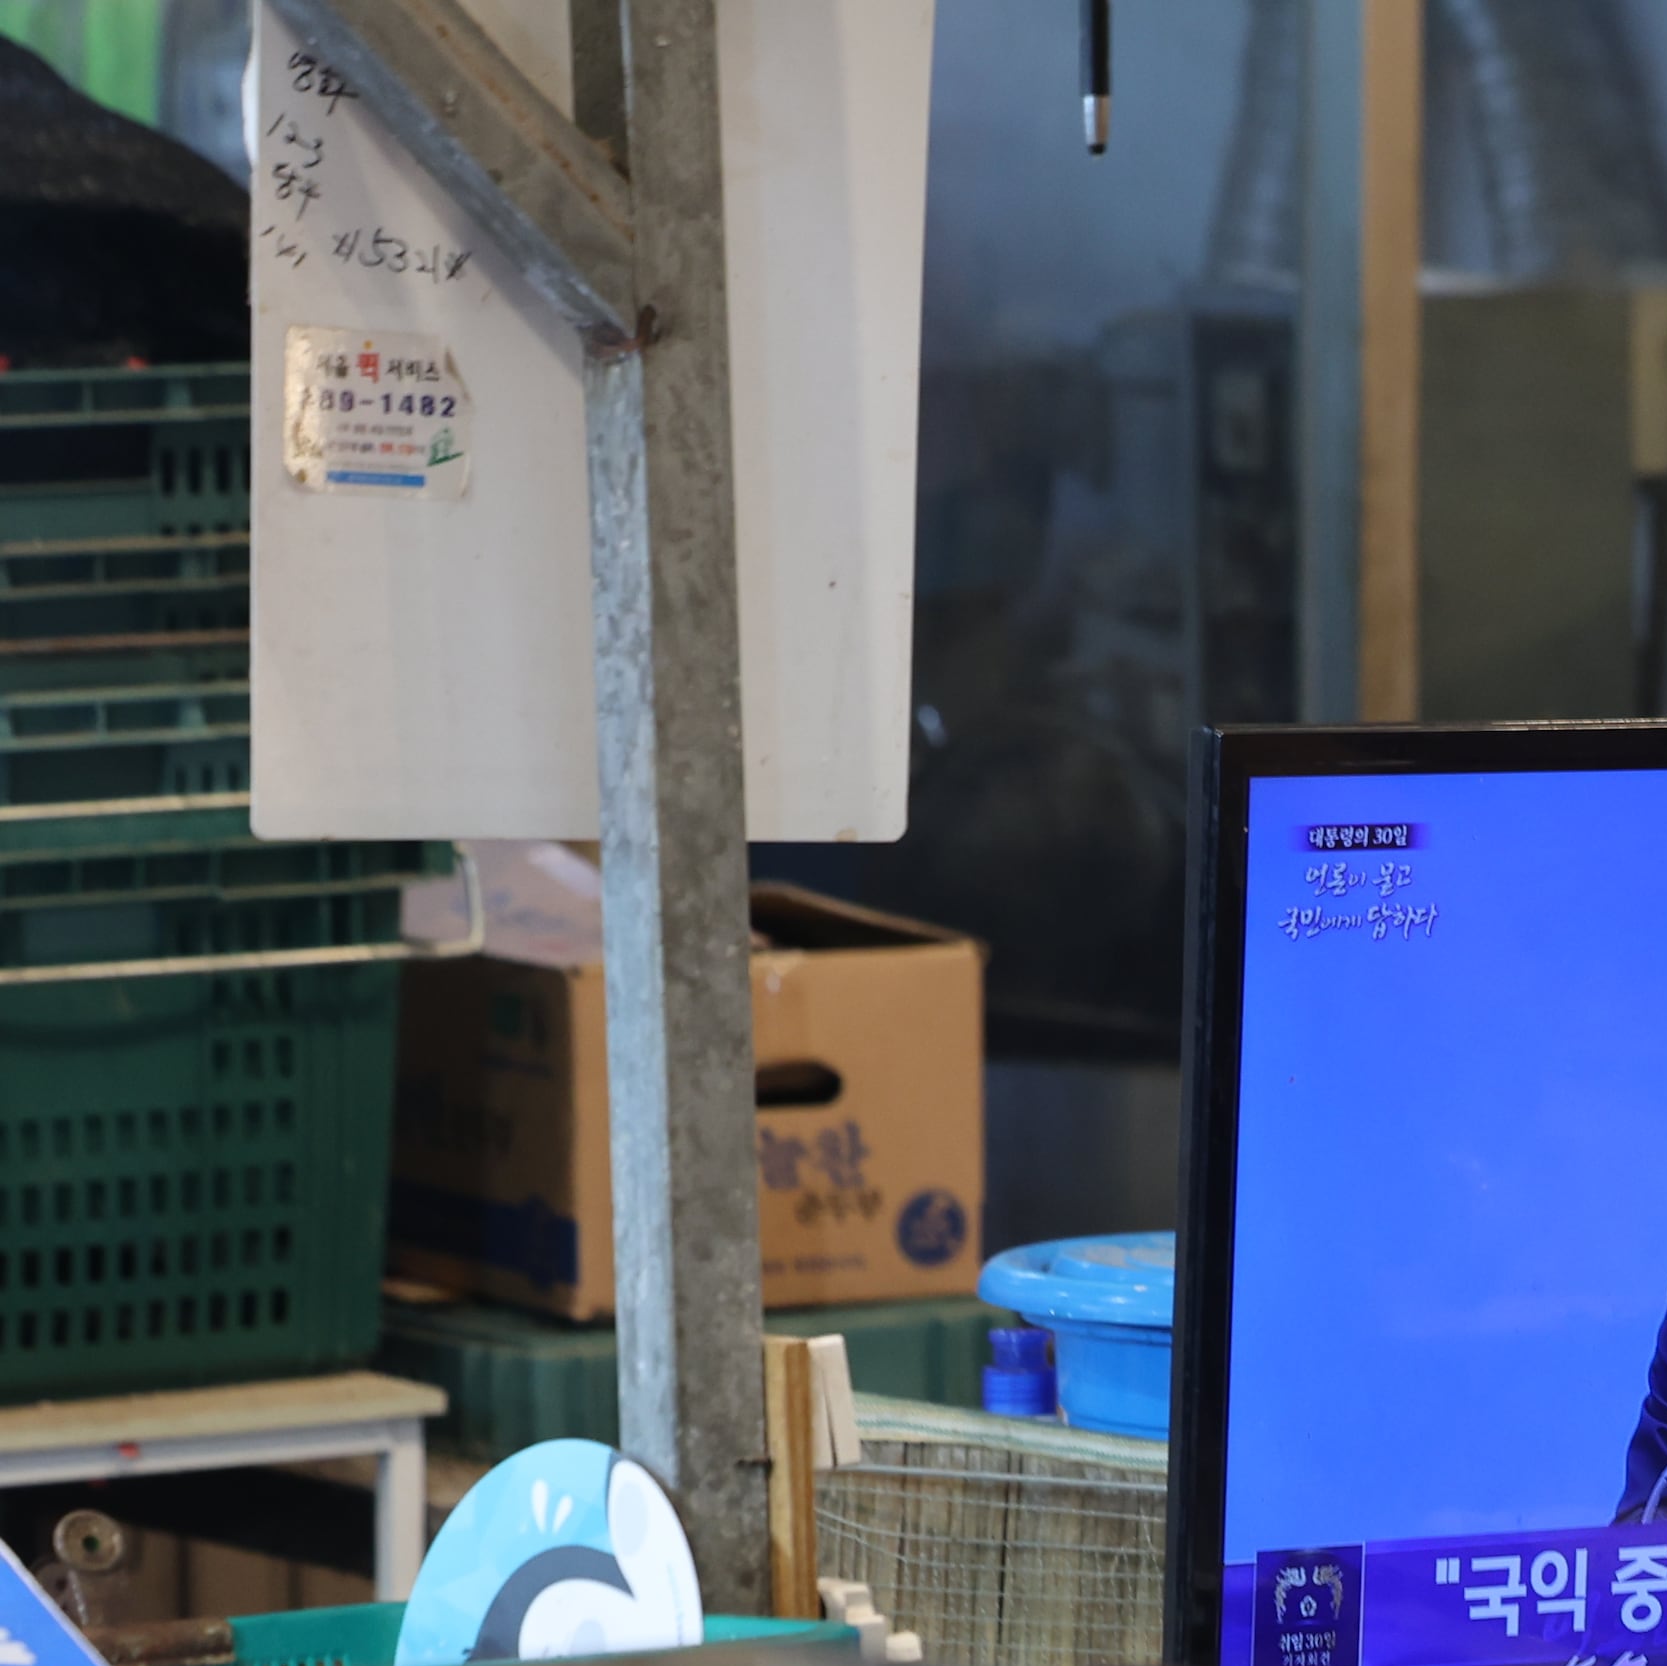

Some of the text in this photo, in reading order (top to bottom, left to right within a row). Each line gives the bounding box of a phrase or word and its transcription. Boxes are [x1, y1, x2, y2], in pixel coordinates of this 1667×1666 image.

[386, 359, 440, 382] 서비스
[301, 387, 457, 418] 89-1482
[1309, 825, 1407, 848] 대통령의 30일
[1305, 862, 1366, 897] 언론이
[1278, 903, 1438, 941] 국민에게 답하다
[1435, 1548, 1588, 1637] "국익
